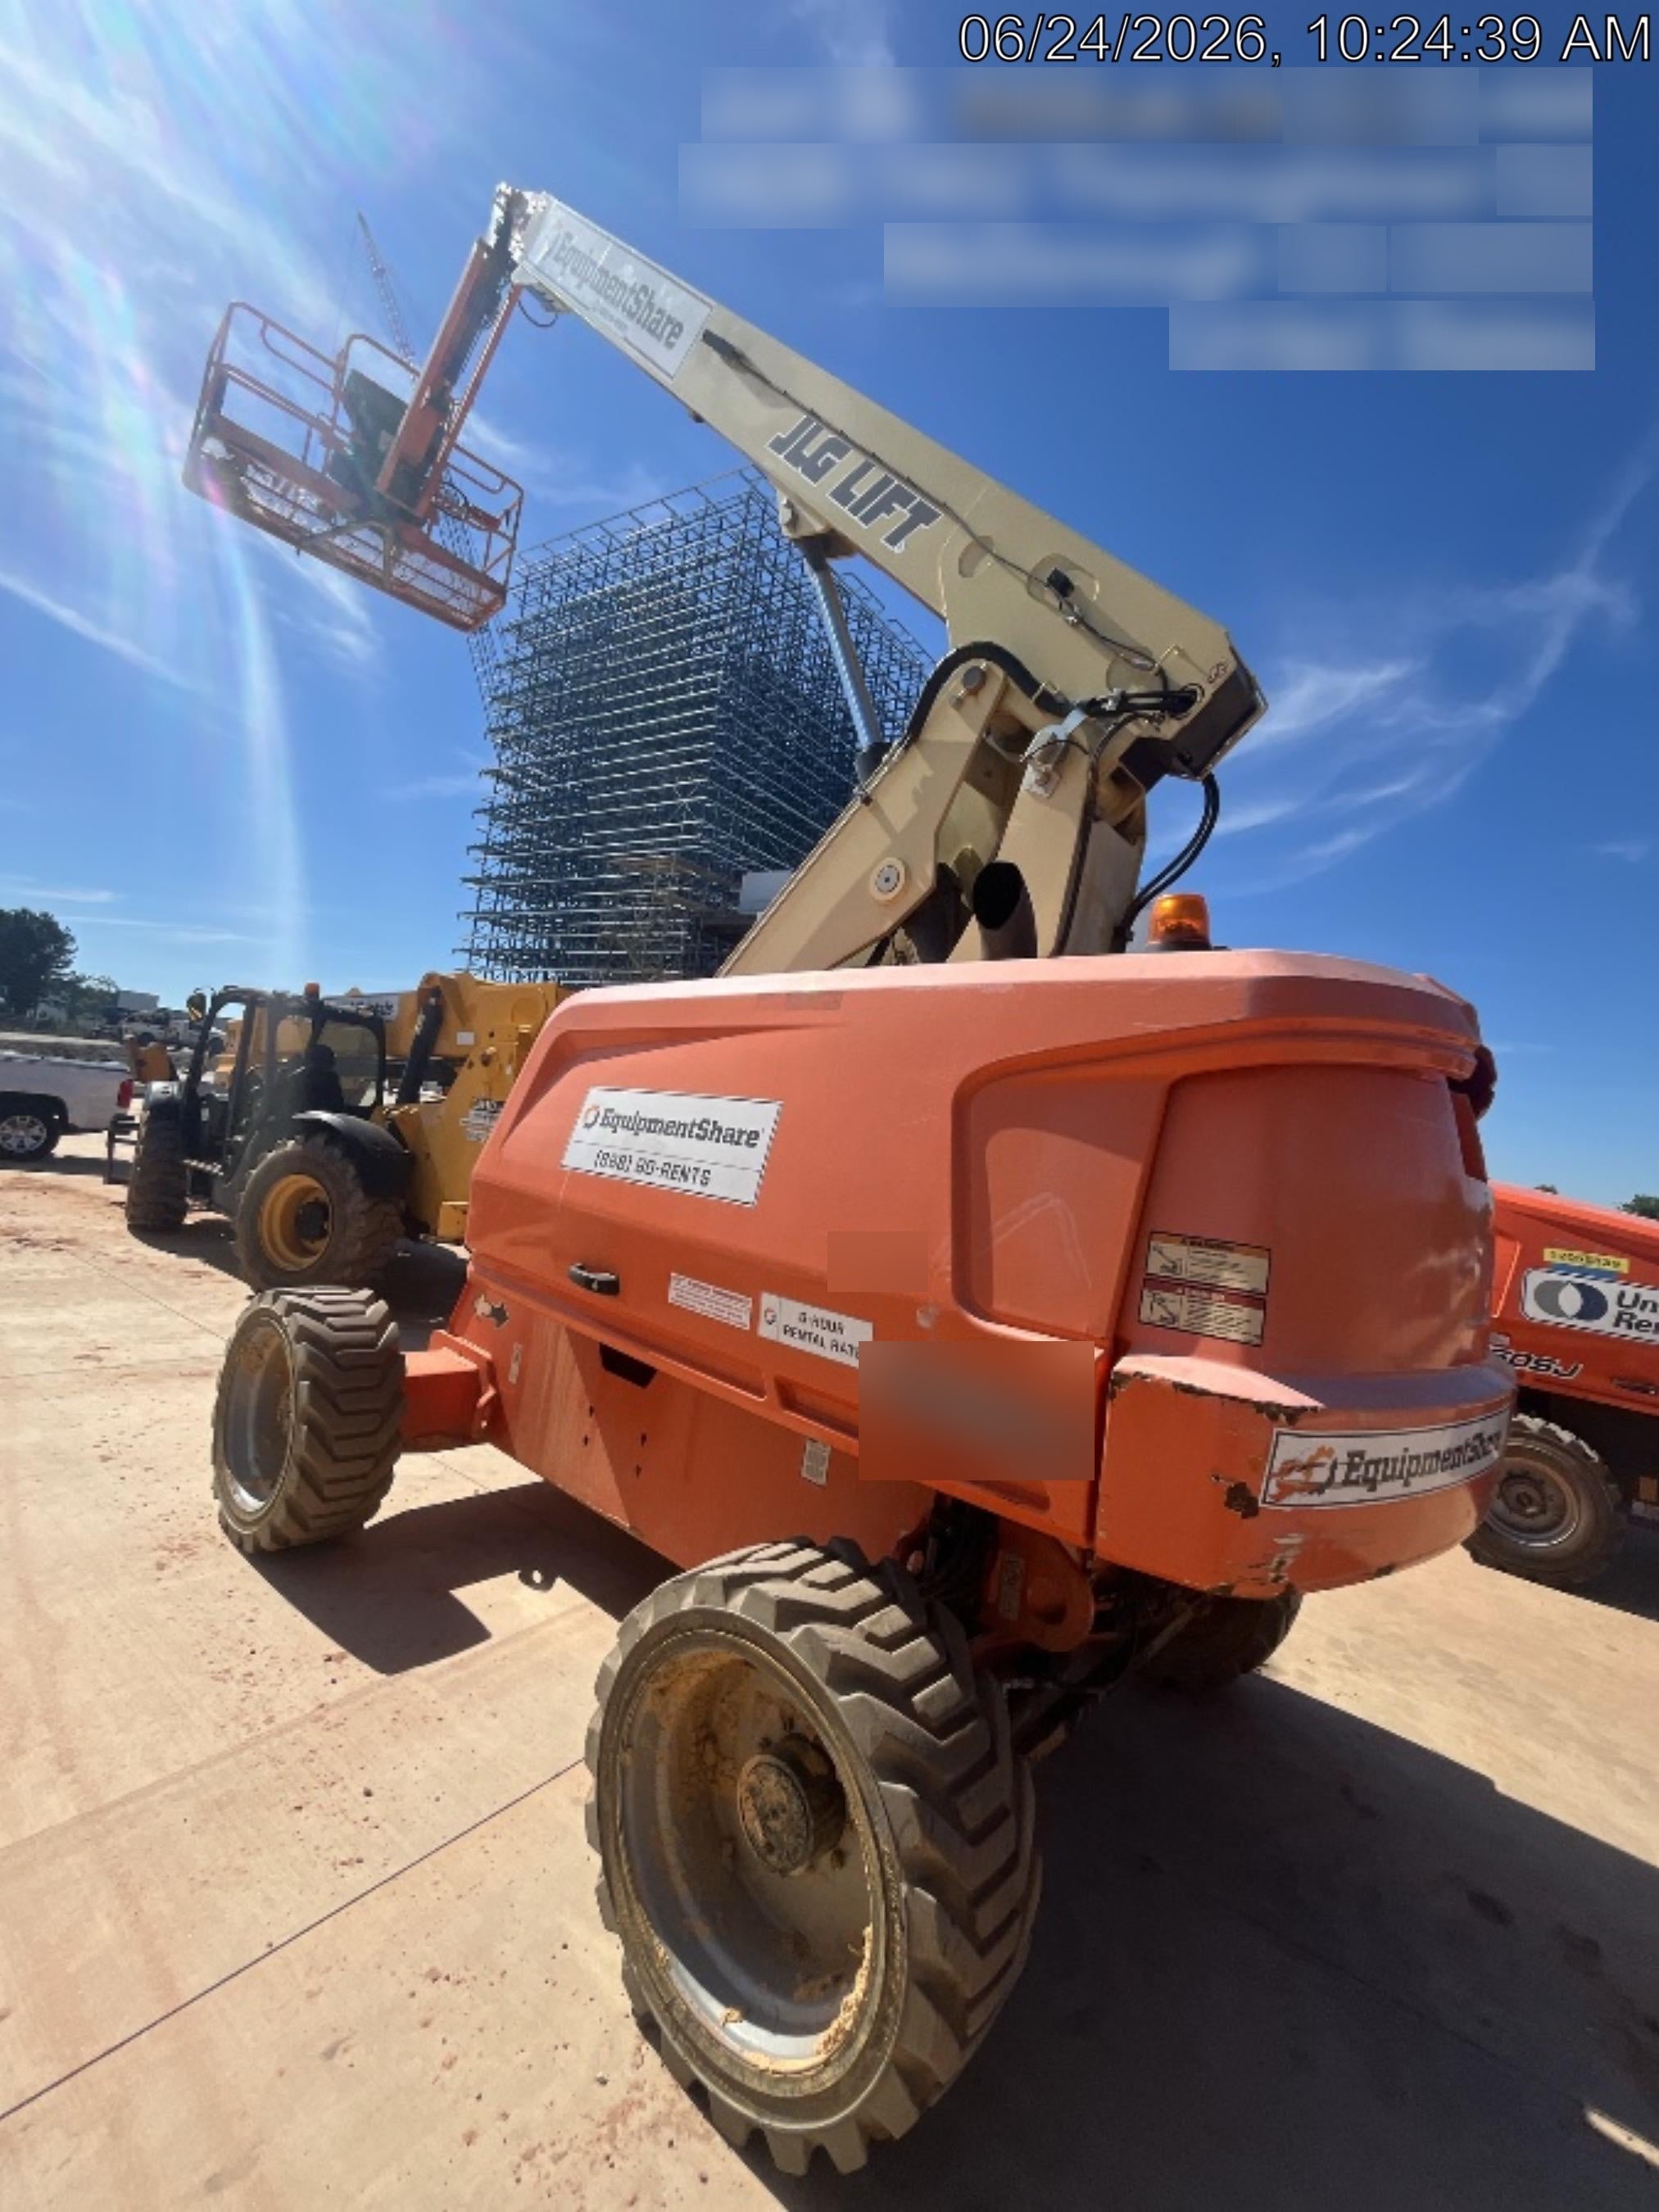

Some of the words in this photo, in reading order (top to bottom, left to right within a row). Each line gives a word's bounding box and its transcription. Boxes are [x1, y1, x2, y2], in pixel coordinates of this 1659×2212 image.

[764, 414, 854, 487] JLG
[826, 458, 944, 553] LIFT
[600, 1108, 760, 1149] EquipmentShare
[783, 1324, 826, 1350] RENTAL
